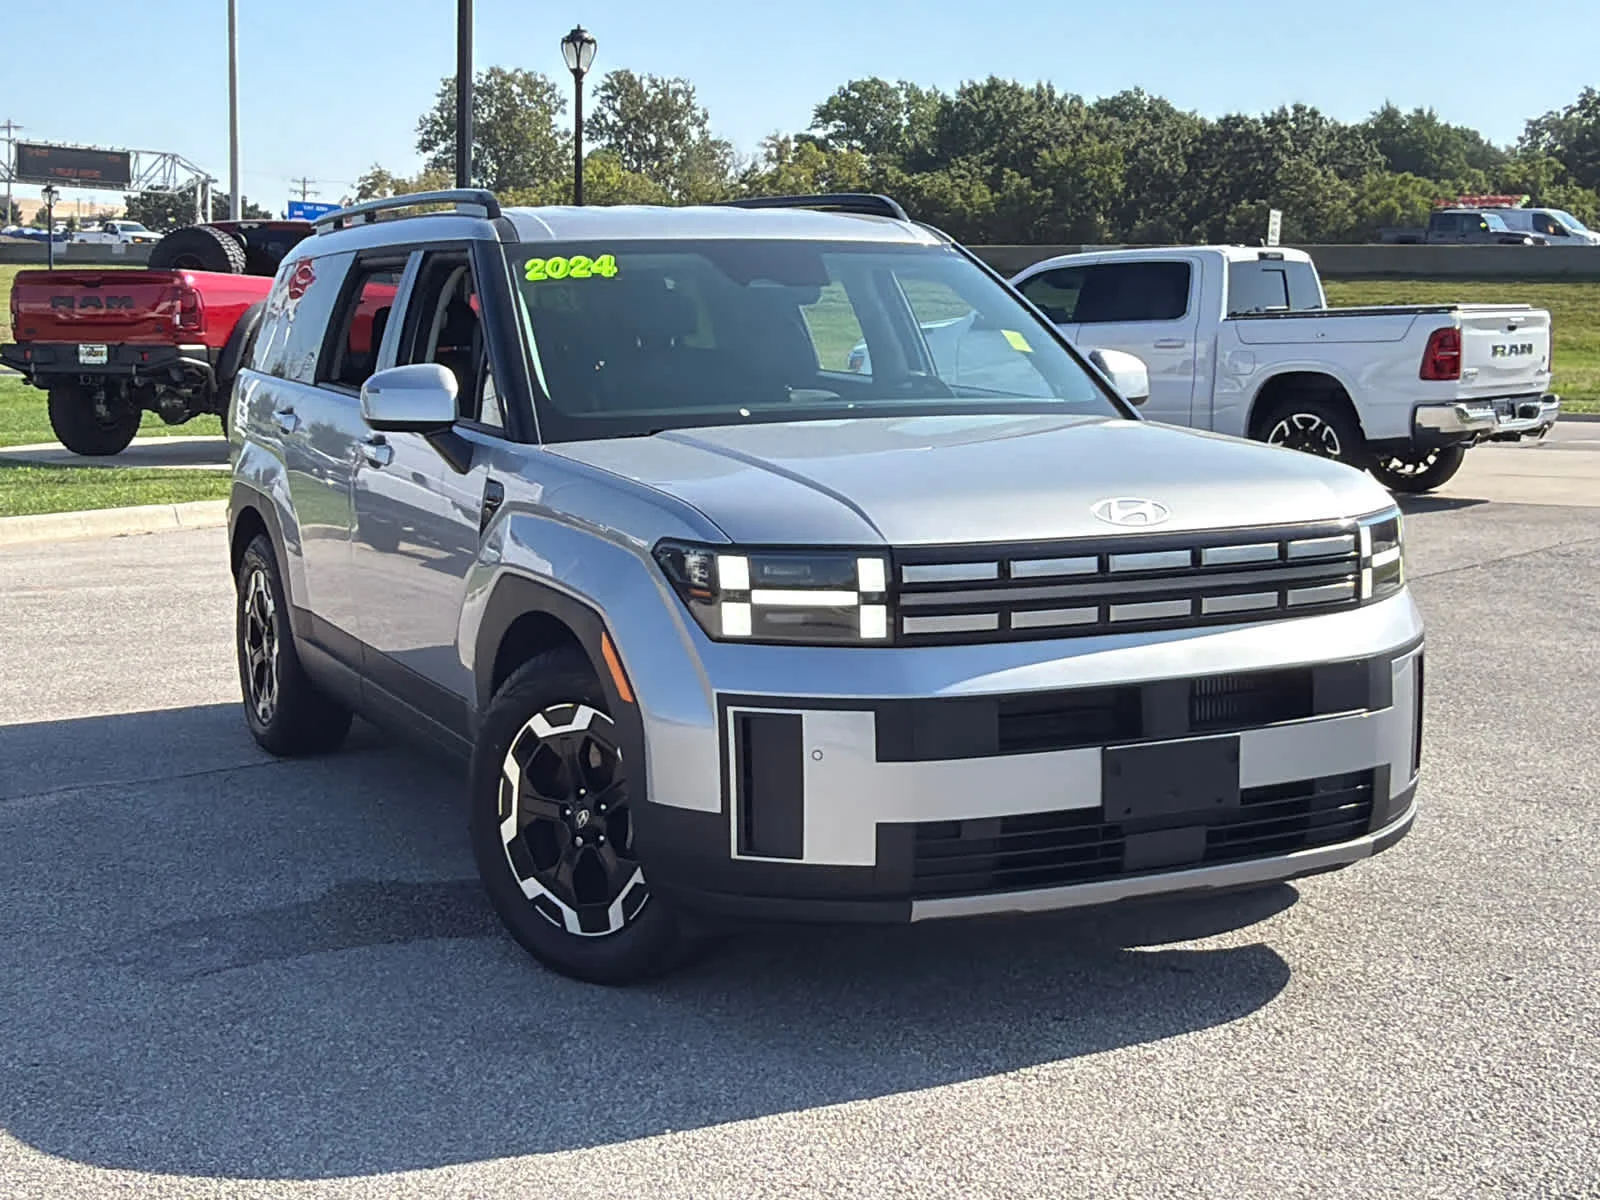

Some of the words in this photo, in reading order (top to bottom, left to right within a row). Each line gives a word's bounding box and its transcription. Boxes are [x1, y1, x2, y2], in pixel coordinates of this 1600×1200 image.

[524, 254, 618, 281] 2024
[51, 295, 135, 309] RAM
[1491, 343, 1533, 358] RAM
